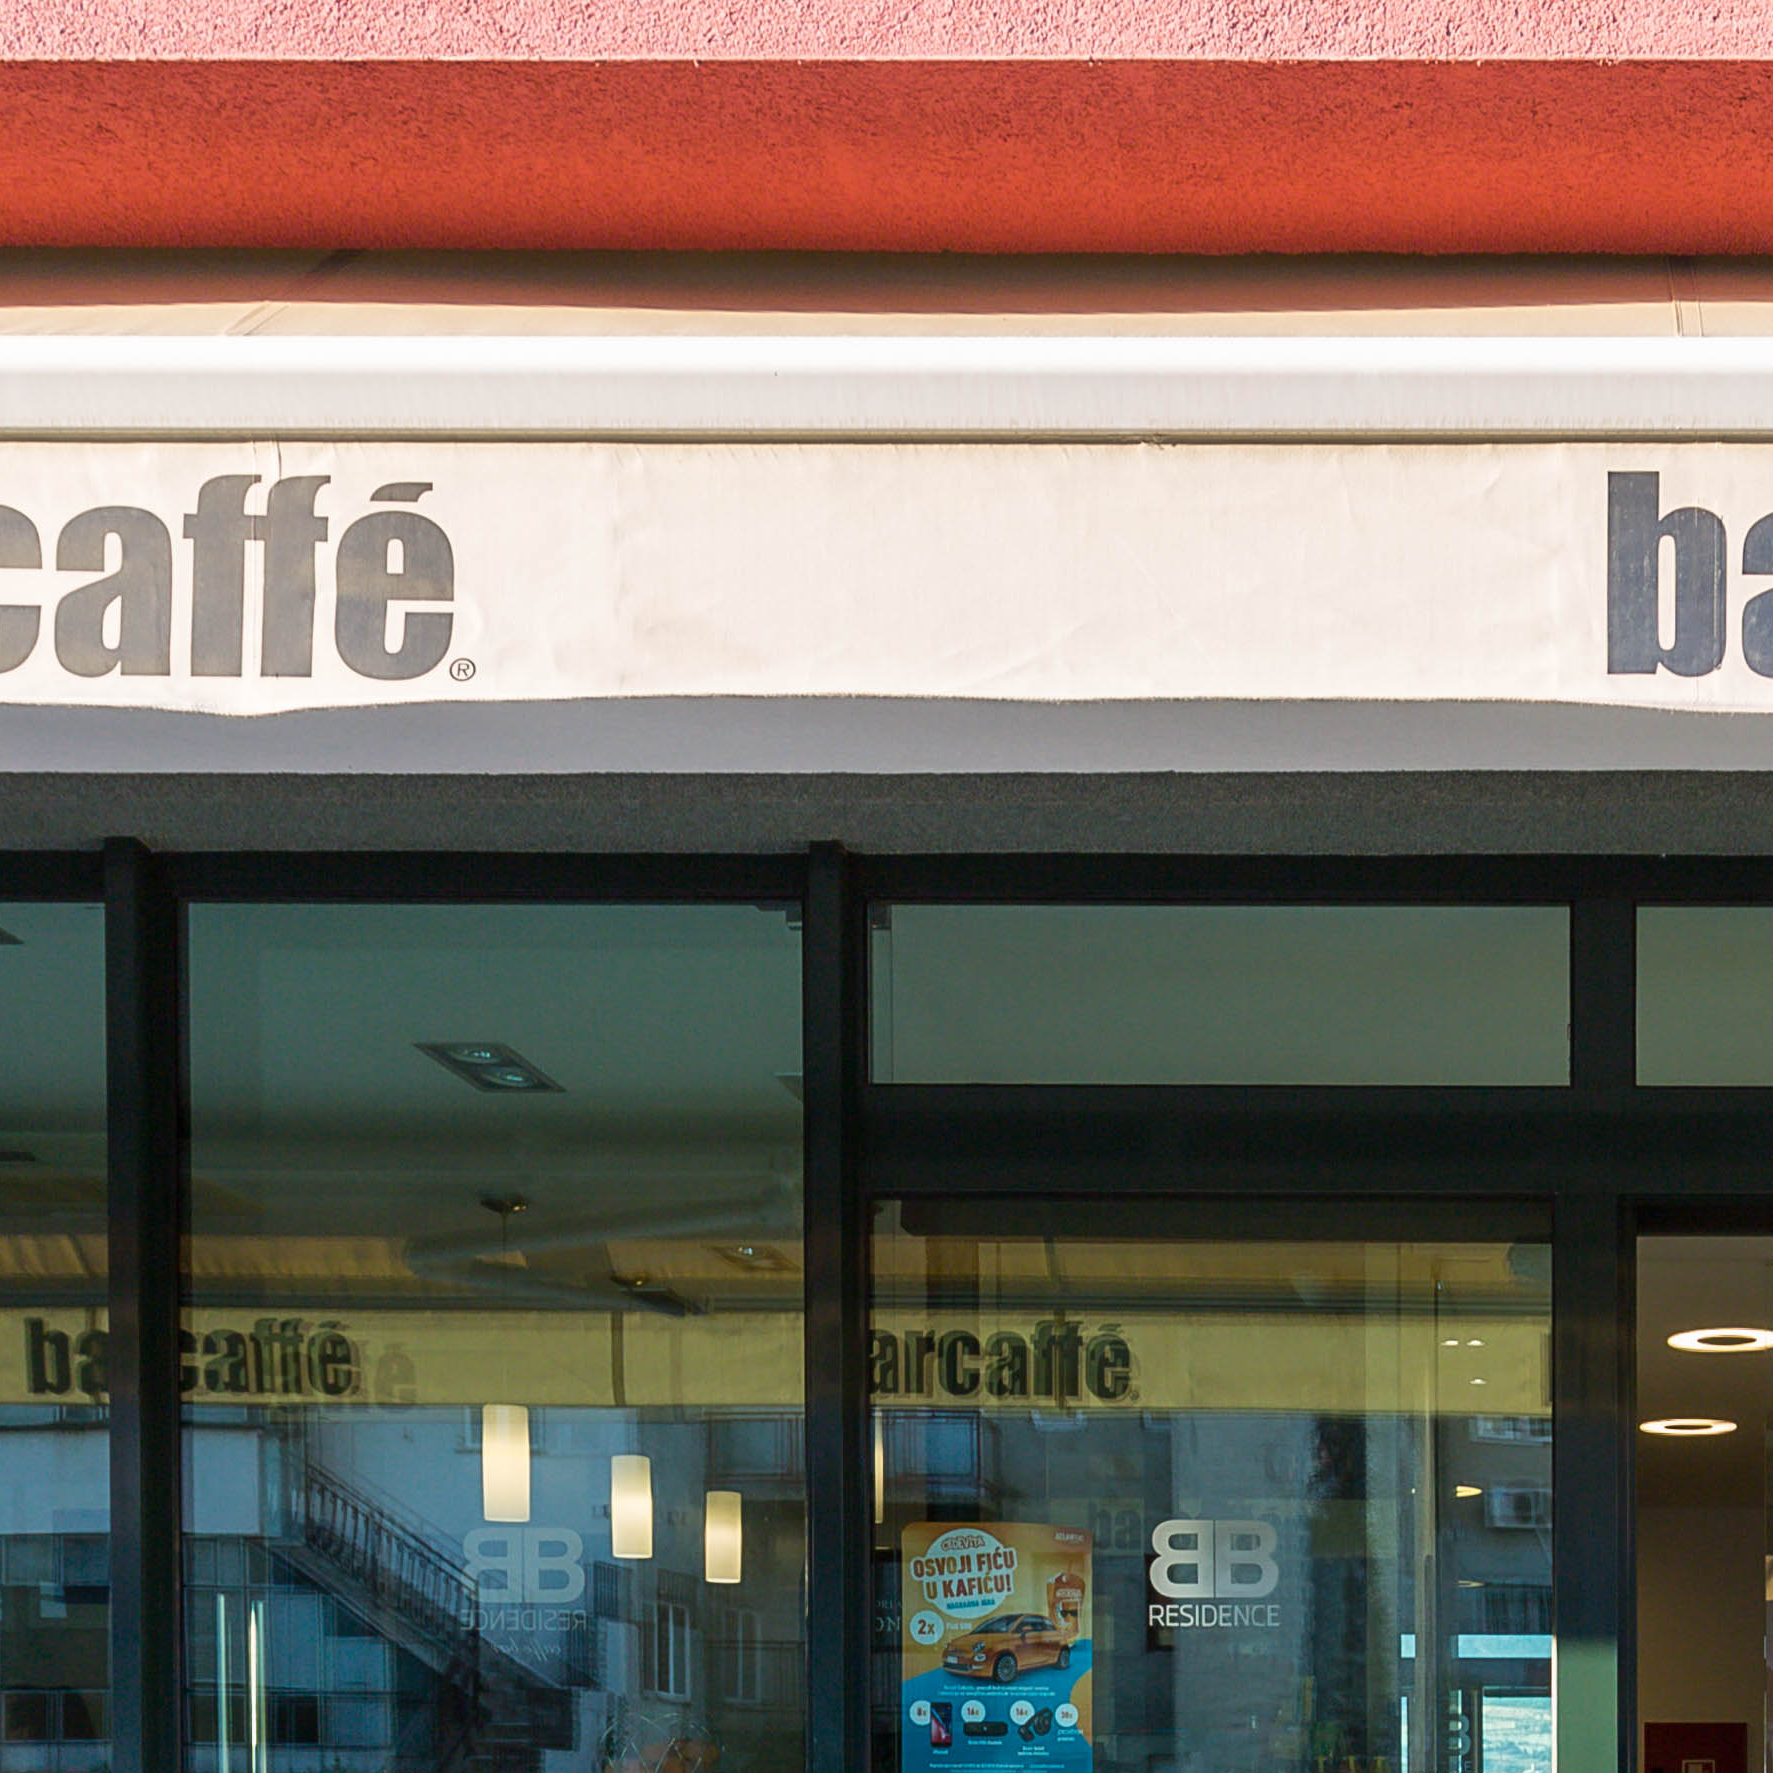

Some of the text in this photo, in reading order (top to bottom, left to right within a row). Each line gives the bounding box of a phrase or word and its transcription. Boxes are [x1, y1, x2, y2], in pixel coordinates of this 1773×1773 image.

[913, 1546, 1015, 1578] OSVOJI FIĆU
[925, 1570, 1011, 1599] U KAFIĆU!
[917, 1619, 935, 1635] 2x
[1149, 1604, 1281, 1627] RESIDENCE
